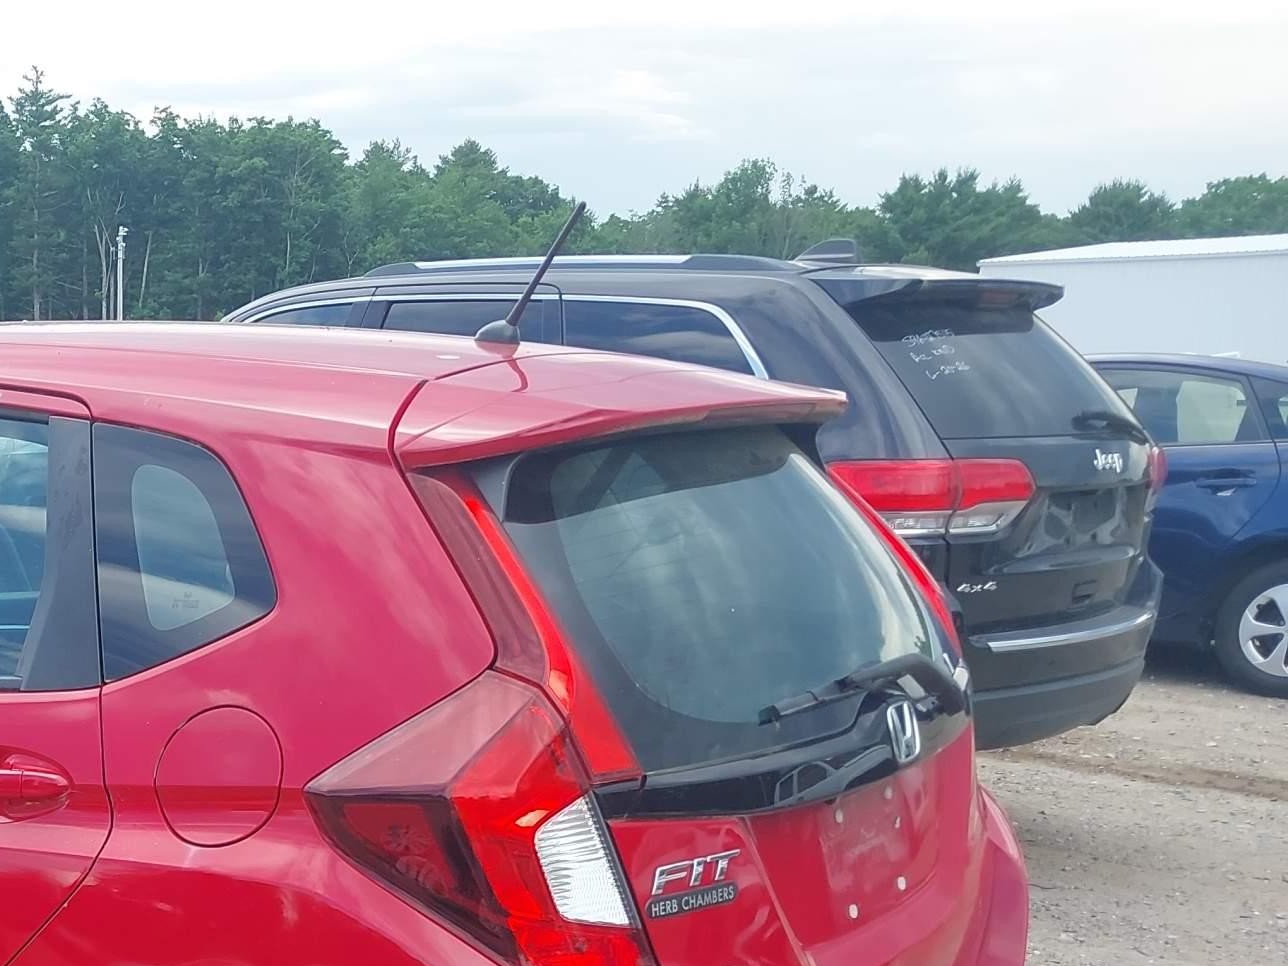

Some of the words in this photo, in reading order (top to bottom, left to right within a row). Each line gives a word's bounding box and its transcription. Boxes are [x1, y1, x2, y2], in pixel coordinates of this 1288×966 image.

[1093, 449, 1123, 473] Jeep
[652, 848, 740, 895] FIT
[652, 899, 678, 917] HERB
[681, 886, 734, 910] CHAMBERS
